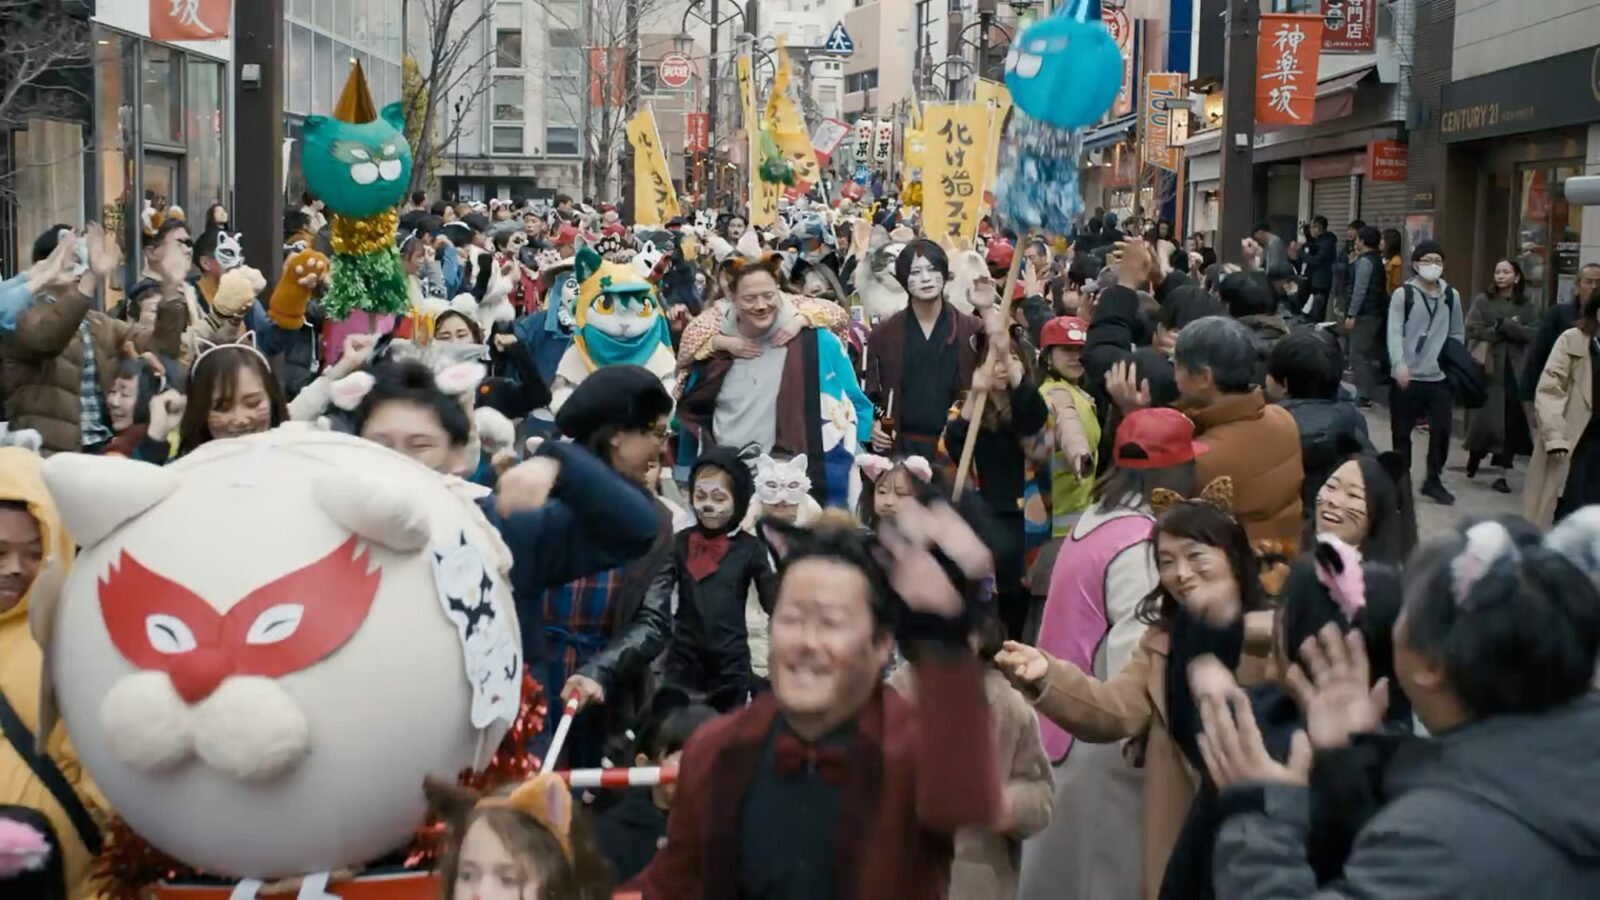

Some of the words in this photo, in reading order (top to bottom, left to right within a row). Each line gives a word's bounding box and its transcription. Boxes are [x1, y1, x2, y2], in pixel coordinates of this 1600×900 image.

[1260, 22, 1305, 120] 神楽坂
[1441, 104, 1487, 132] CENTURY
[1488, 103, 1499, 125] 21
